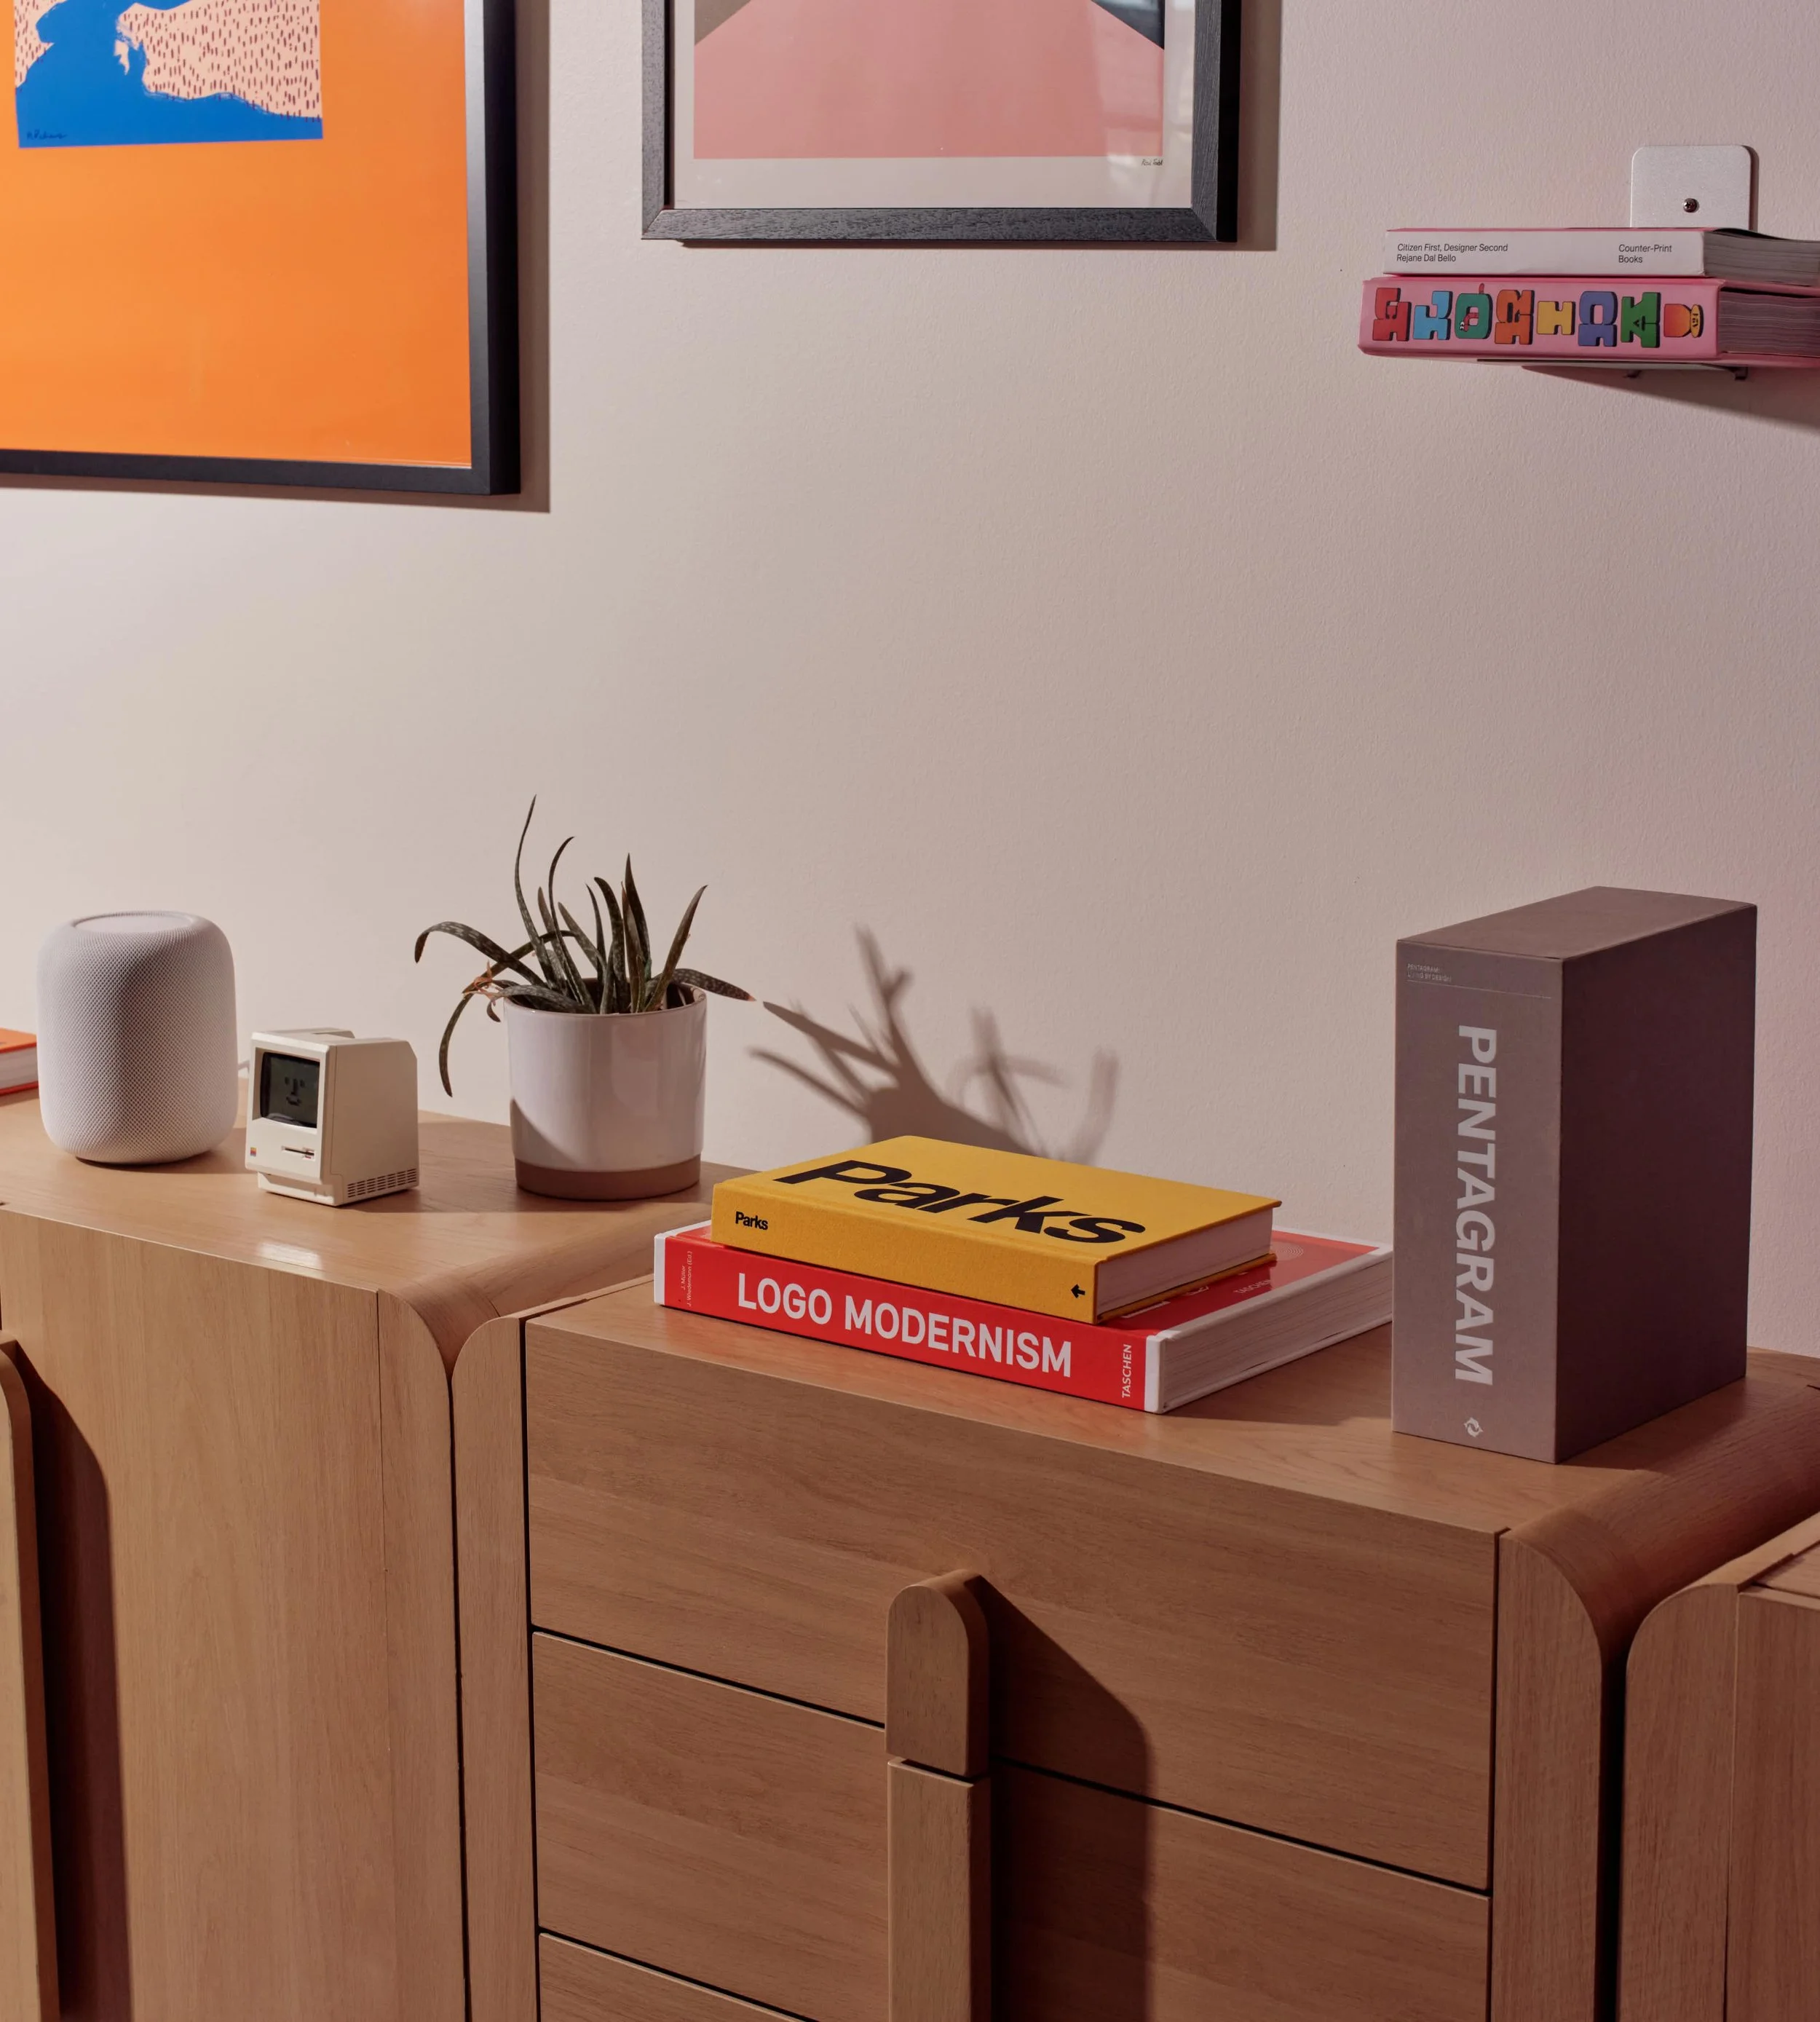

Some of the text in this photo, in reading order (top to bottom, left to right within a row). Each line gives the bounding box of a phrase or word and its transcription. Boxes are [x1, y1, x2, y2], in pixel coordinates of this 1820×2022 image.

[1396, 253, 1457, 263] Rejane Dal Bello
[1397, 243, 1508, 253] Citizen First, Designer Second
[1618, 244, 1672, 253] Counter-Print
[1618, 255, 1643, 263] Books
[772, 1160, 1146, 1244] Parks
[1455, 1024, 1497, 1386] PENTAGRAM
[735, 1211, 769, 1231] Parks
[737, 1272, 1072, 1378] LOGO MODERNISM
[1122, 1343, 1132, 1398] TASCHEN
